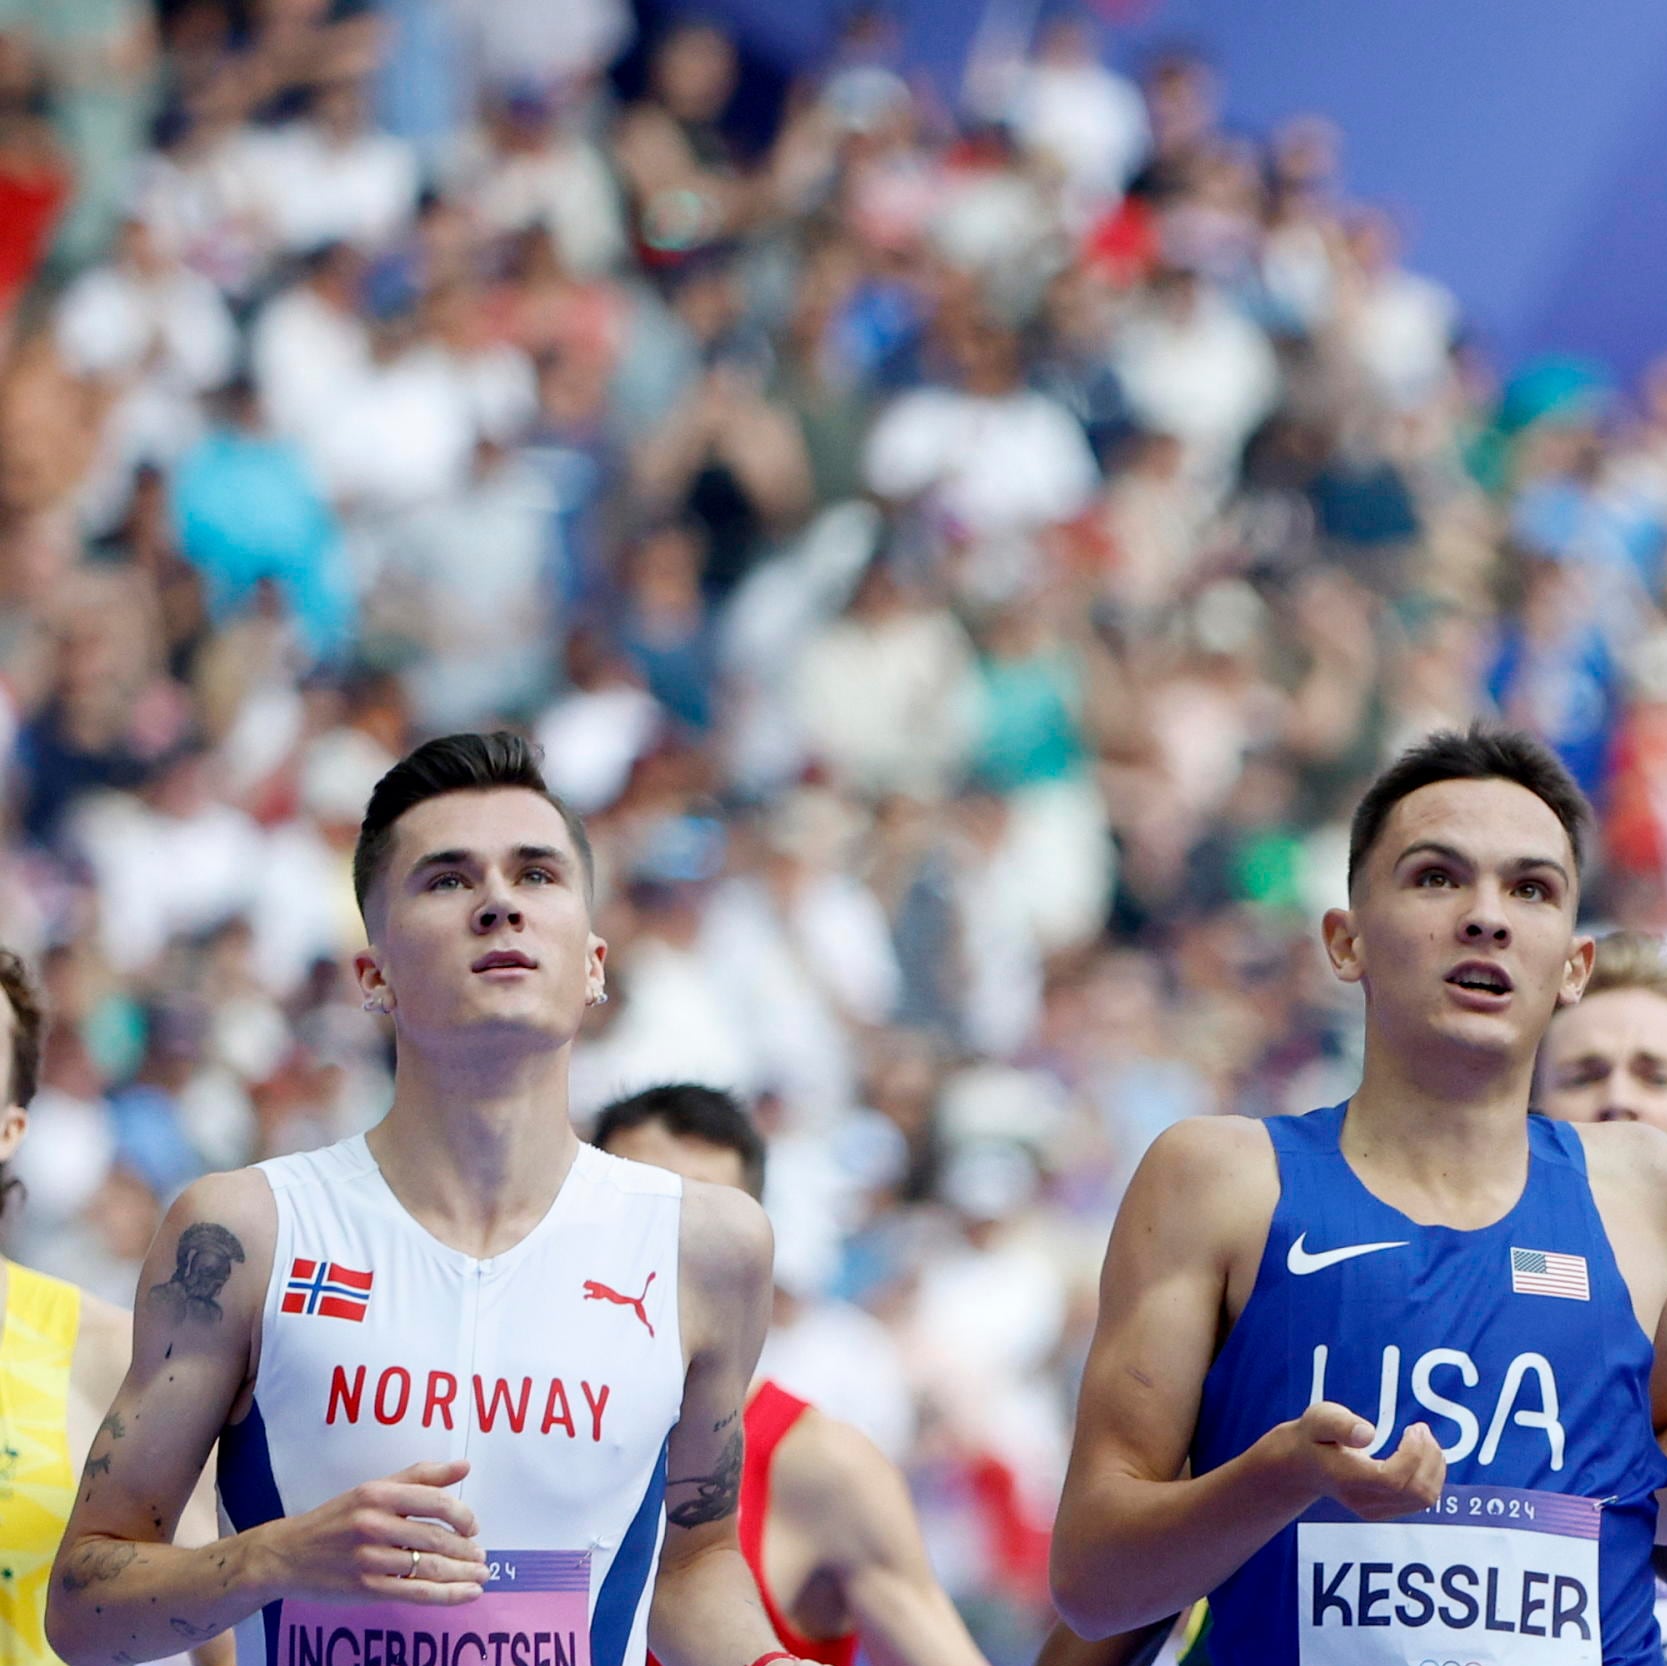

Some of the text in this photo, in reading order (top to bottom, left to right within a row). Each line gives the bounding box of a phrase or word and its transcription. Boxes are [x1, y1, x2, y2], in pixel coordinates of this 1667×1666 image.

[325, 1364, 610, 1442] NORWAY
[1309, 1344, 1565, 1471] USA
[489, 1561, 516, 1581] 24
[1312, 1562, 1592, 1641] KESSLER
